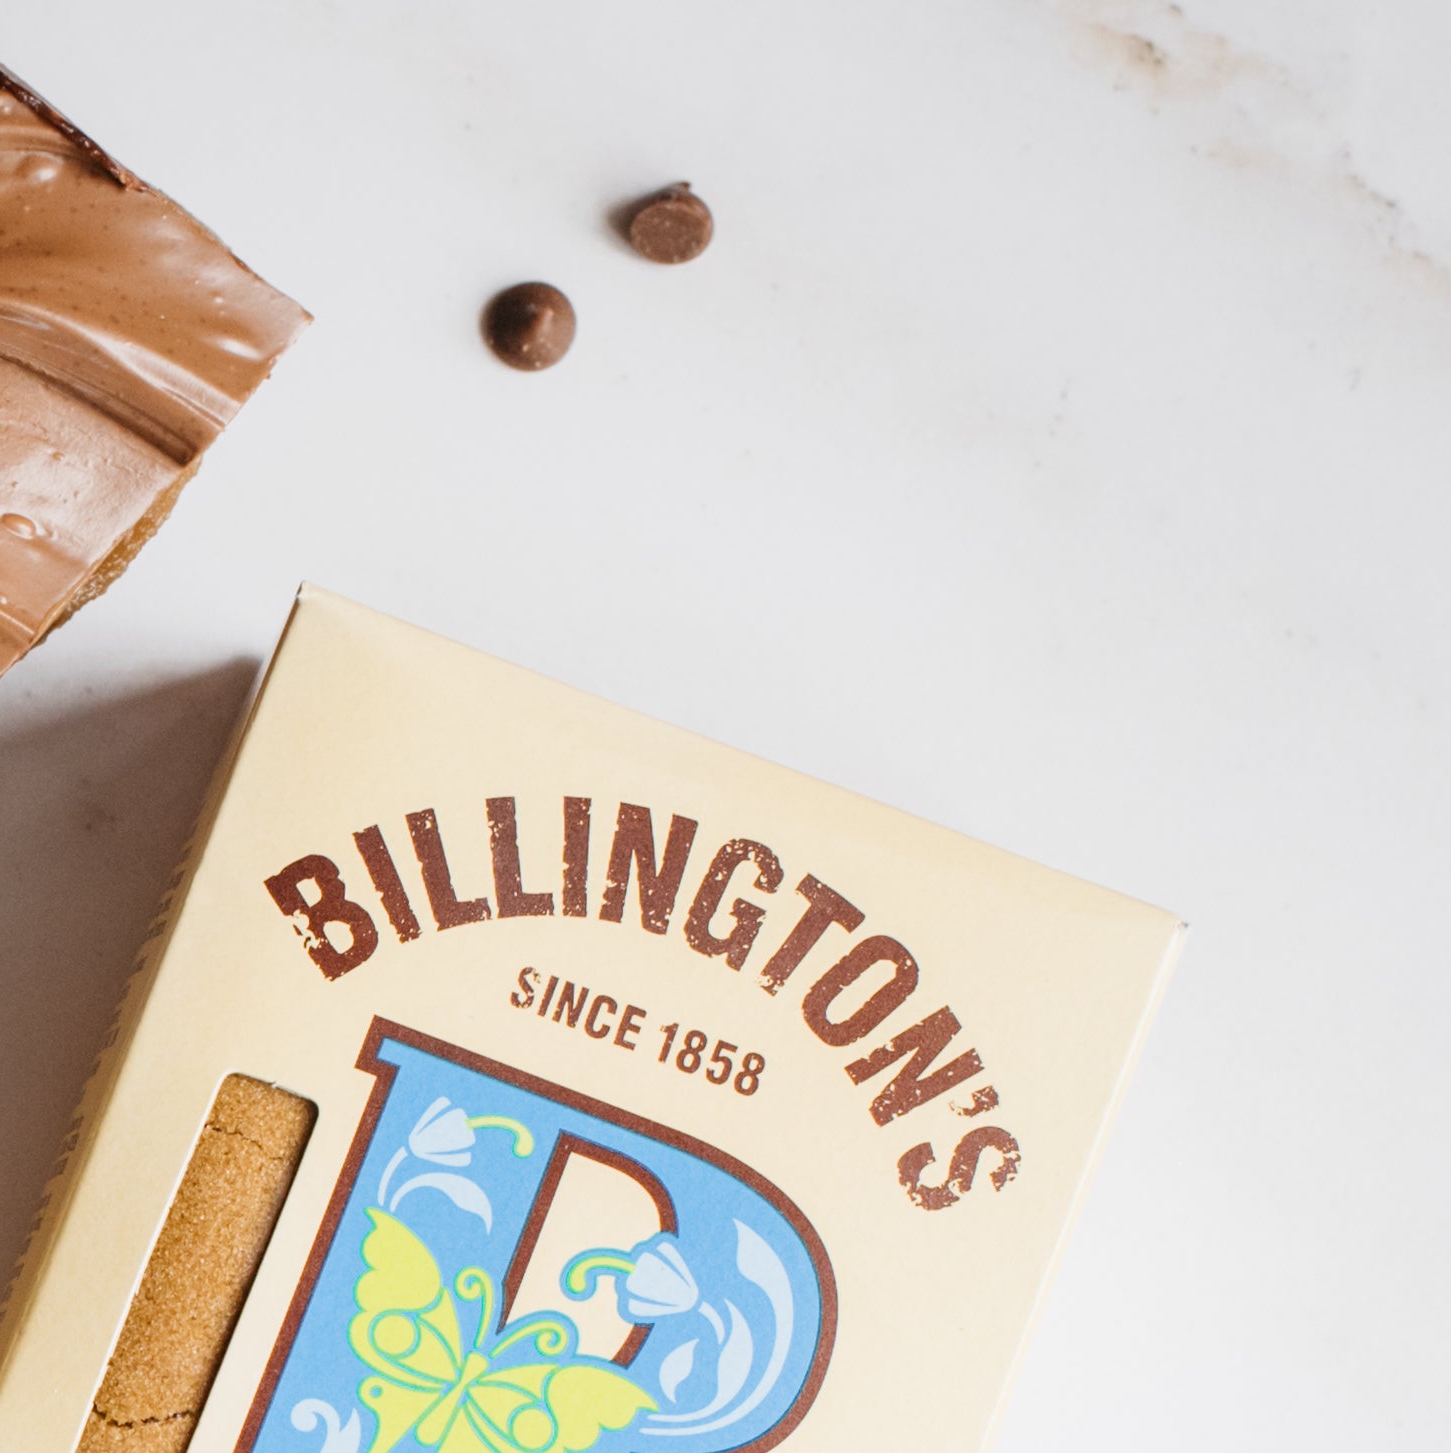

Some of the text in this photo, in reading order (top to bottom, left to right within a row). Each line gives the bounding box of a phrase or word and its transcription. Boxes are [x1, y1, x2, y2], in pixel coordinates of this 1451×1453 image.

[263, 796, 1022, 1210] BILLINGTON'S
[510, 966, 765, 1095] SINCE 1858
